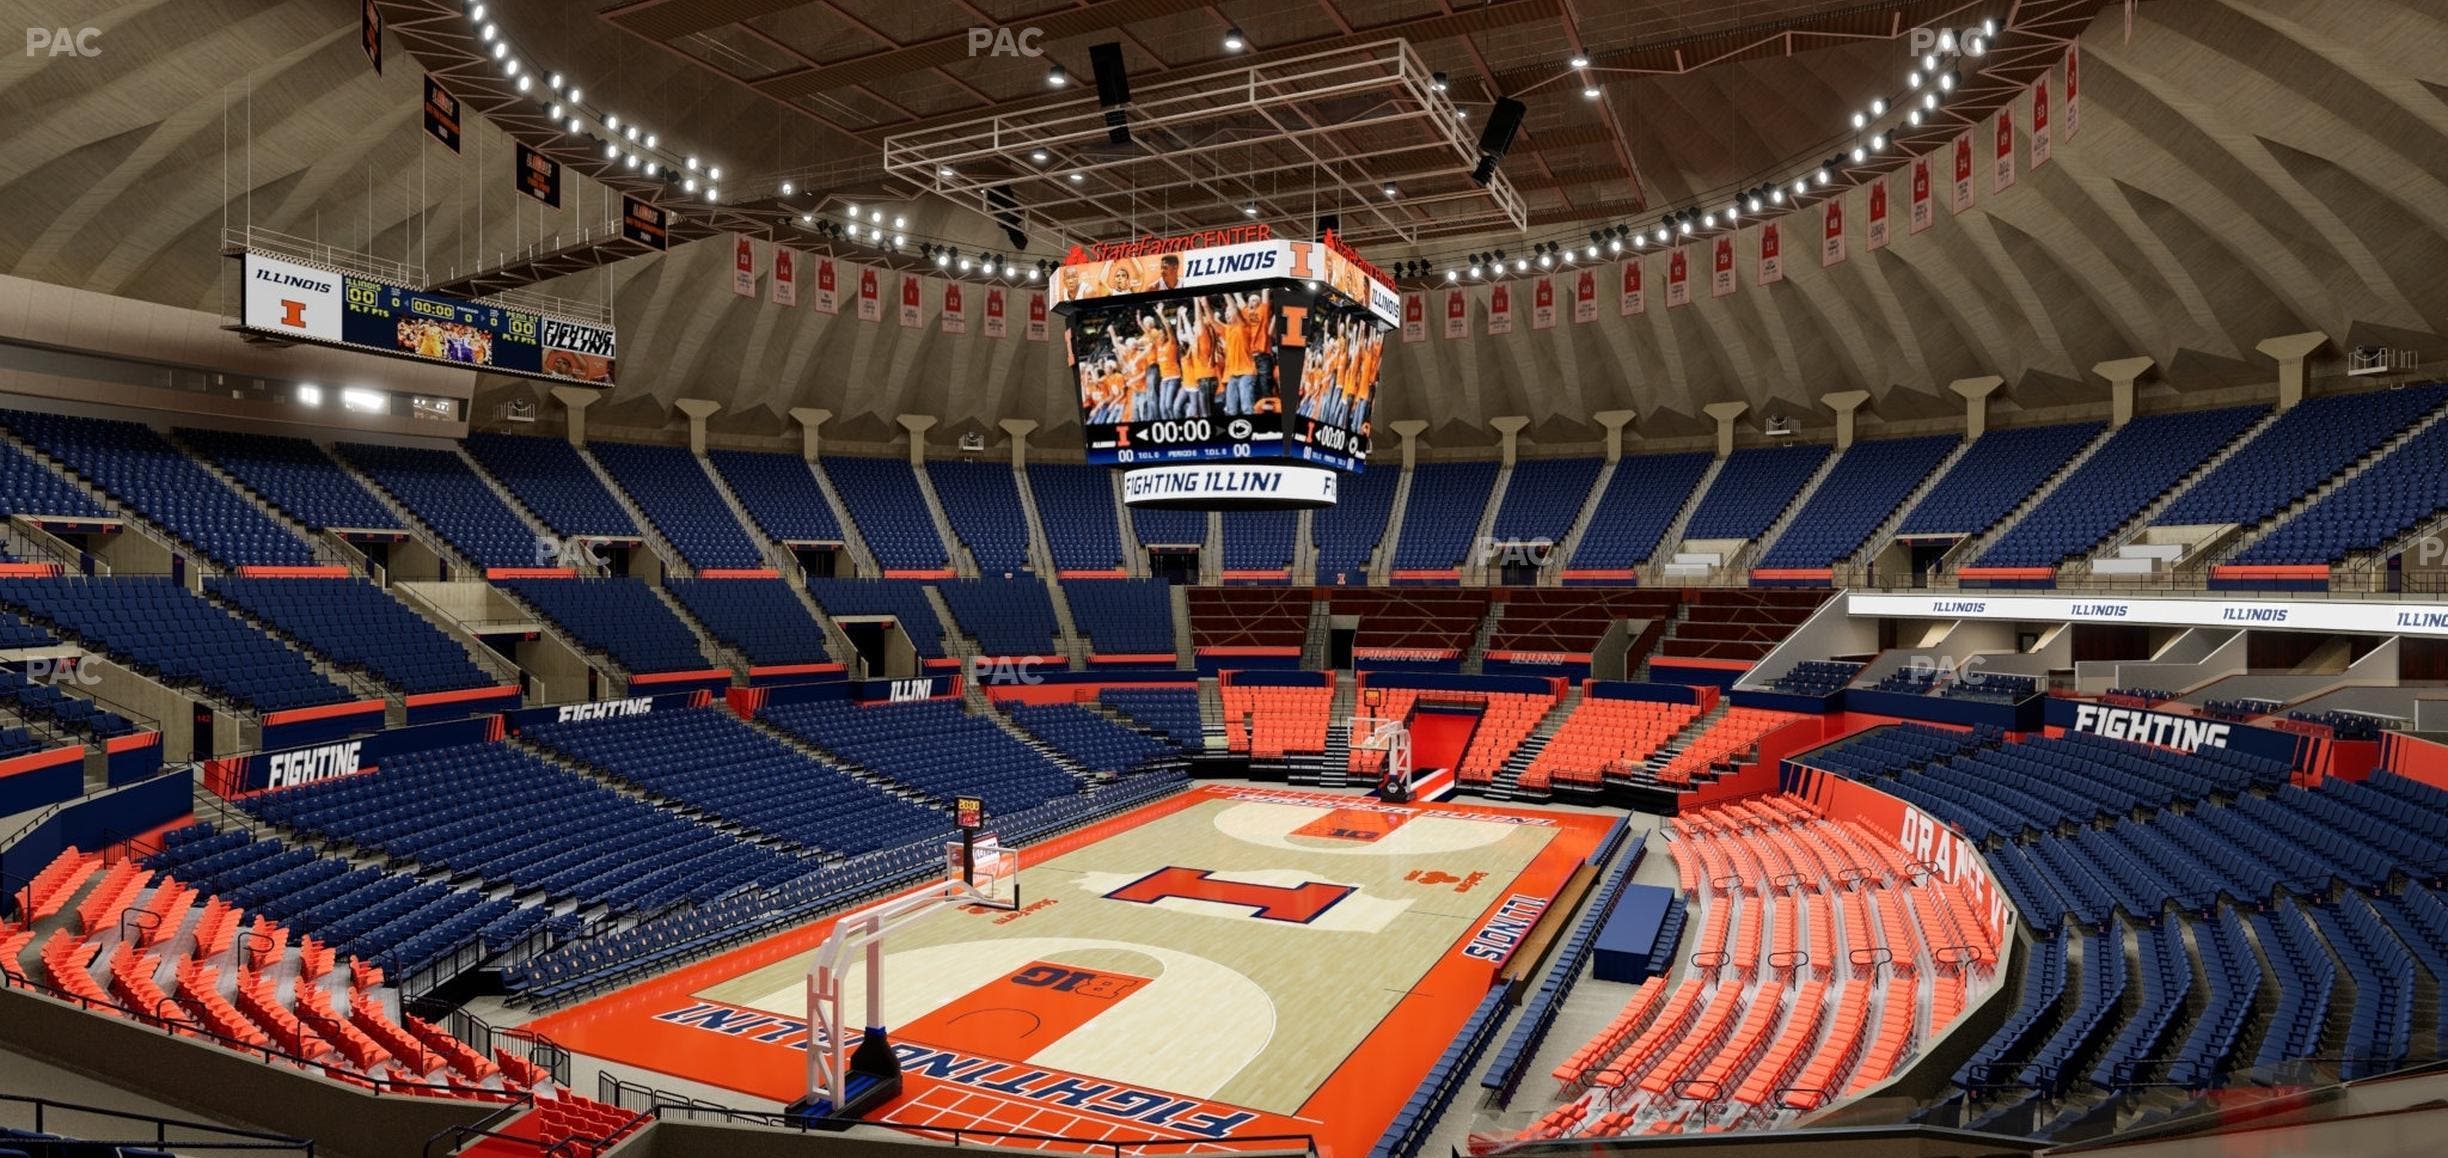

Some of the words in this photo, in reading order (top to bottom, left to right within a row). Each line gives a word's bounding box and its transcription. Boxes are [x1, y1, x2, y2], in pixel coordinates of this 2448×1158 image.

[1186, 250, 1277, 278] ILLINOIS
[256, 268, 332, 294] ILLINOIS
[350, 288, 375, 305] 00
[414, 301, 453, 317] 00:00
[1372, 288, 1400, 319] ILLINOIS
[512, 321, 534, 335] 00
[545, 320, 614, 347] FIGHTING
[1151, 419, 1211, 444] 00:00
[1320, 425, 1346, 451] 00:00
[1118, 449, 1134, 463] 00
[1232, 443, 1251, 458] 00
[1126, 472, 1199, 497] FIGHTING
[1204, 472, 1282, 492] ILLINI
[1932, 602, 1986, 613] ILLINOIS
[2071, 604, 2128, 616] ILLINOIS
[2223, 608, 2288, 622] ILLINOIS
[889, 679, 933, 702] ILLINI
[558, 697, 653, 723] FIGHTING
[2074, 704, 2231, 754] FIGHTING
[268, 741, 362, 791] FIGHTING
[1462, 893, 1550, 963] ILLINOIS
[890, 1041, 1262, 1140] FIGHTING
